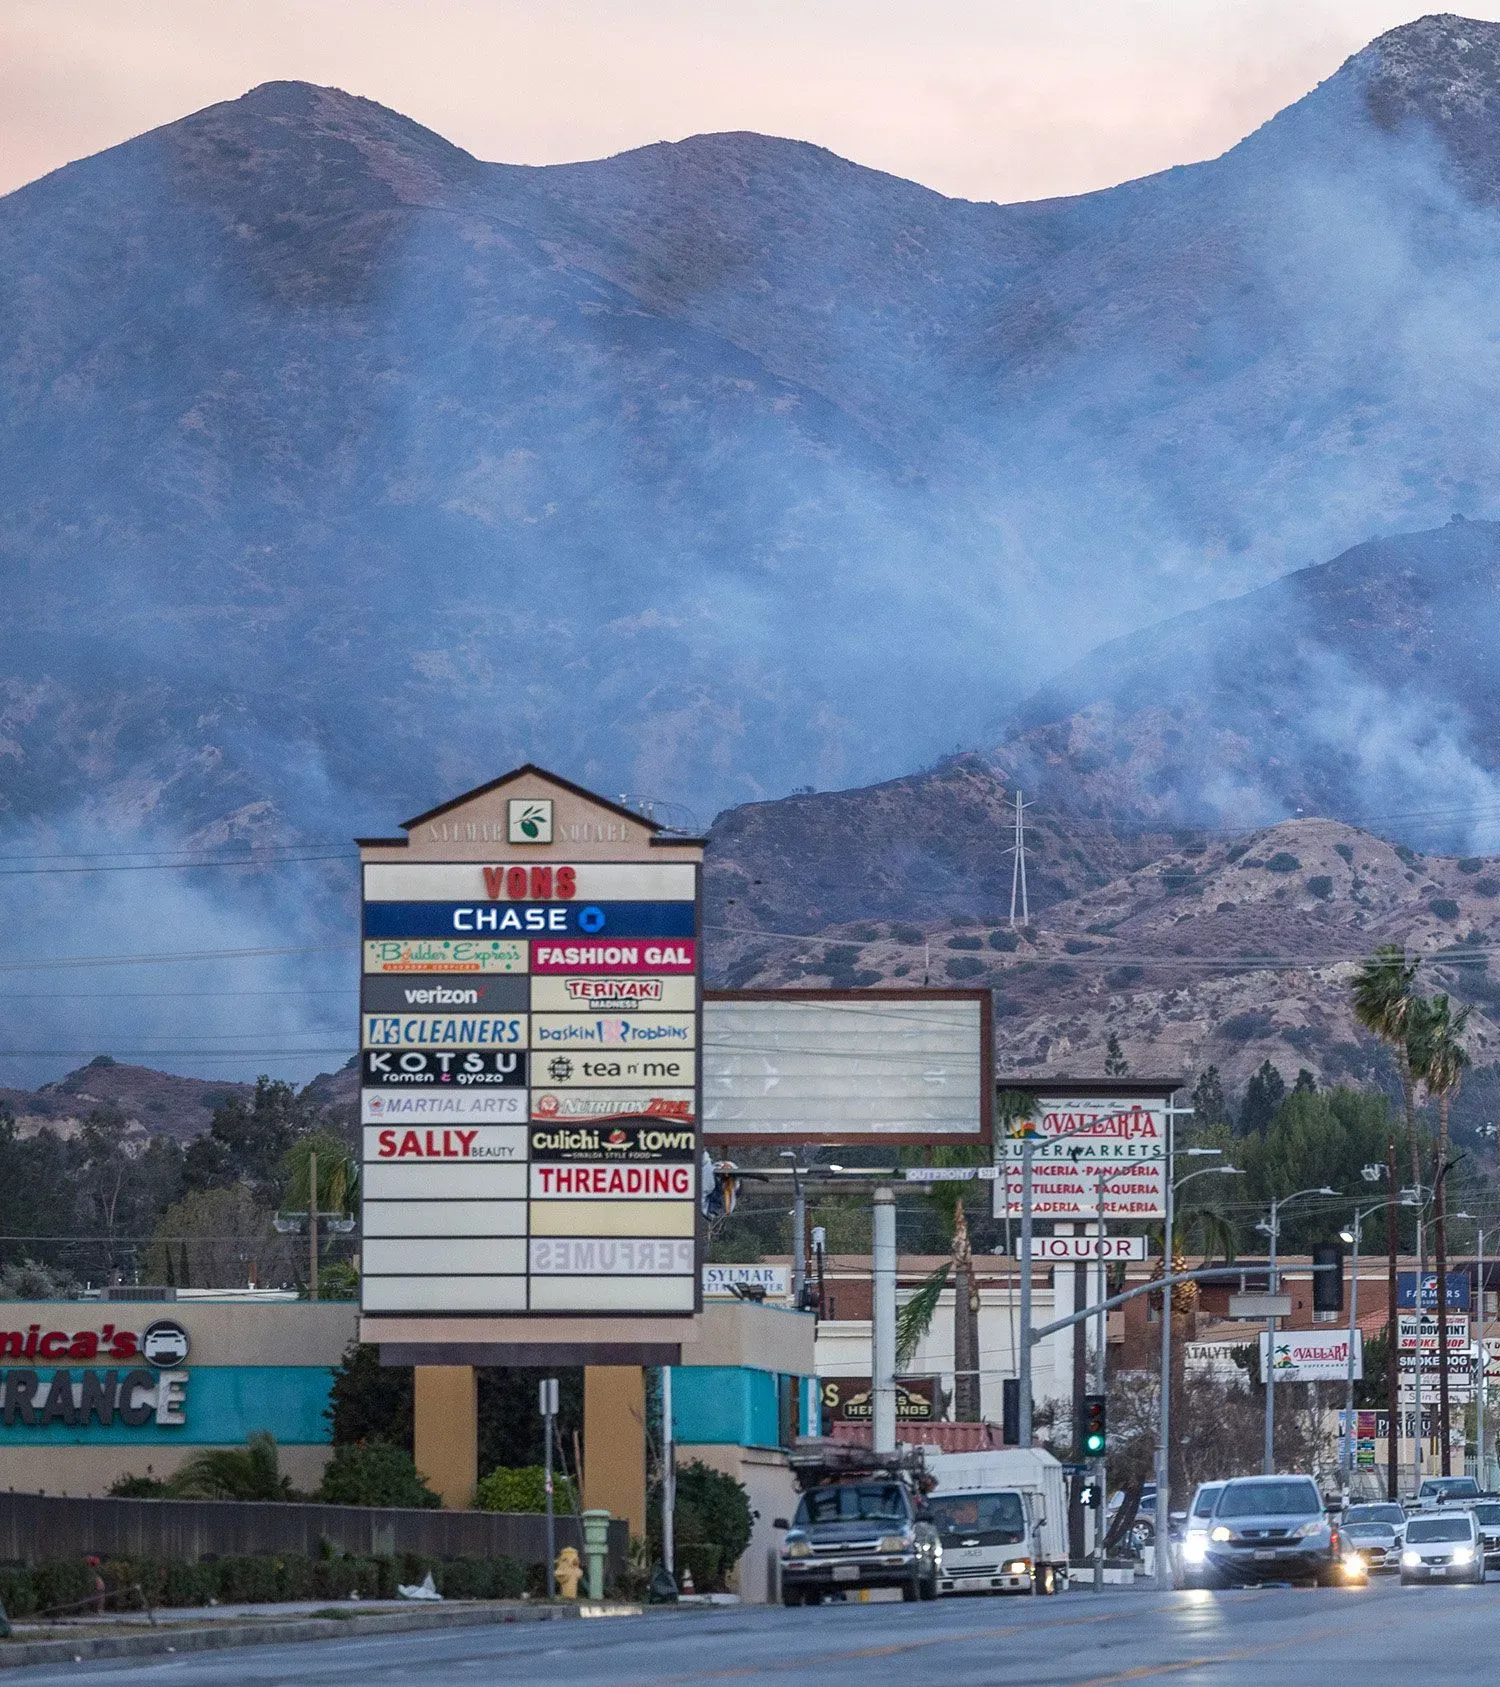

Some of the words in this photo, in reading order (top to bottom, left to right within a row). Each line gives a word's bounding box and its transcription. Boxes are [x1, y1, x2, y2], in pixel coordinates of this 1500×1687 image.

[560, 823, 629, 843] SQUARE
[482, 866, 577, 900] VONS
[453, 908, 569, 931] CHASE
[379, 942, 448, 962] Boulder
[453, 942, 521, 969] Express
[537, 947, 639, 965] FASHION
[644, 947, 692, 965] GAL
[404, 985, 478, 1004] verizon
[568, 981, 660, 998] TERIYAKI
[590, 1000, 638, 1009] MADNESS
[404, 1019, 521, 1044] CLEANERS
[539, 1026, 595, 1041] baskin
[632, 1025, 689, 1040] robbins
[369, 1052, 517, 1073] KOTSU
[583, 1062, 621, 1077] tea
[643, 1062, 680, 1077] me
[383, 1073, 434, 1082] ramen
[456, 1073, 504, 1084] gyoza
[387, 1098, 465, 1112] MARTIAL
[470, 1098, 518, 1112] ARTS
[1042, 1105, 1158, 1140] VALLARTA
[378, 1130, 479, 1158] SALLY
[472, 1147, 515, 1158] BEAUTY
[532, 1130, 599, 1149] culichi
[638, 1130, 695, 1150] town
[999, 1145, 1162, 1156] SUERMARKETS
[1006, 1166, 1078, 1176] CANICERIA
[1086, 1166, 1159, 1176] PANADERIA
[539, 1168, 689, 1194] THREADING
[1007, 1184, 1084, 1194] TOTILLERIA
[1092, 1184, 1159, 1195] TAQUERIA
[1007, 1202, 1080, 1213] PESADERIA
[1031, 1240, 1131, 1257] IQUOR
[707, 1269, 774, 1282] SYLMAR
[1401, 1325, 1439, 1335] WIDOW
